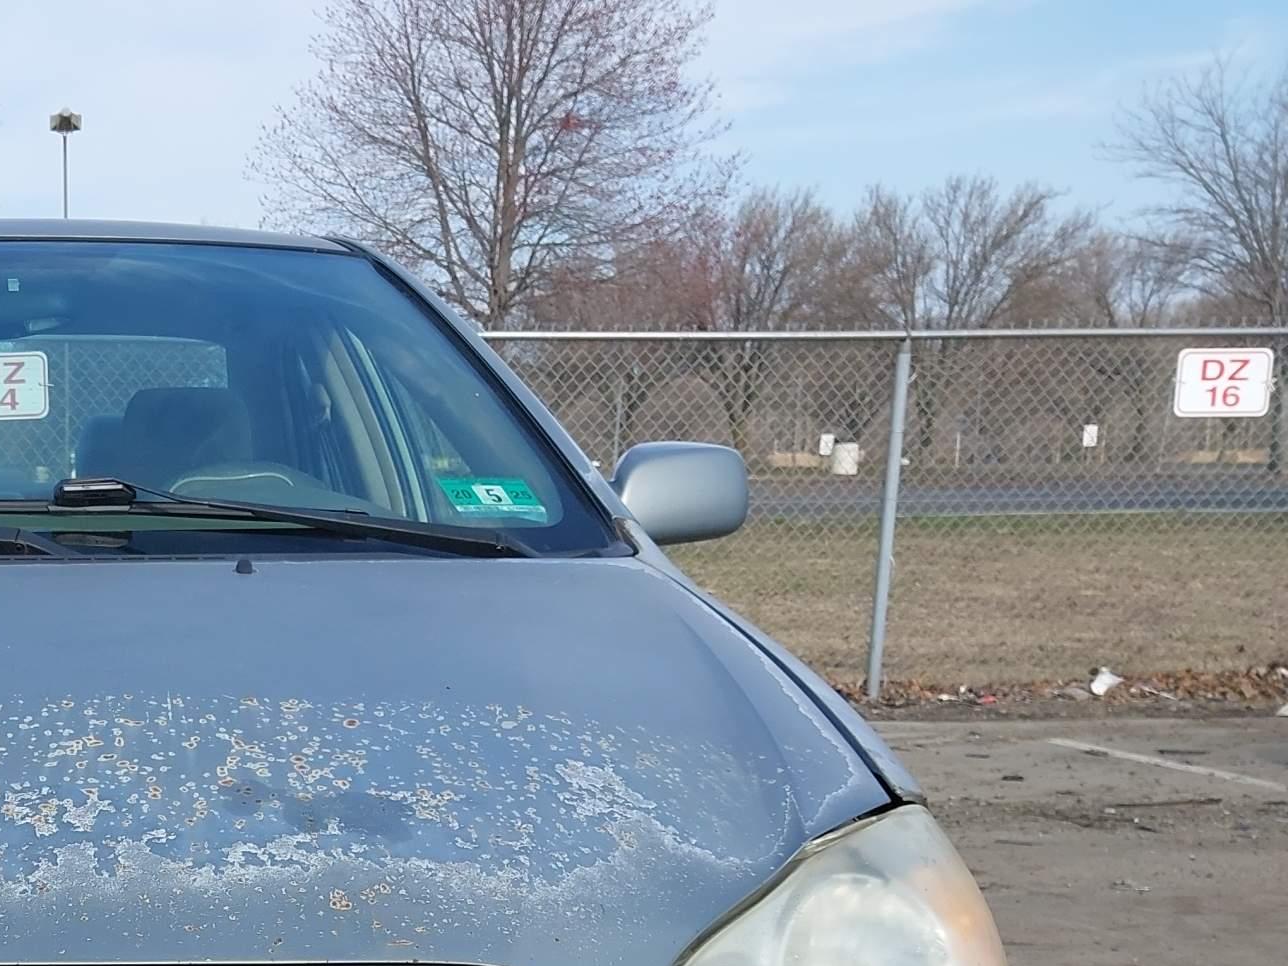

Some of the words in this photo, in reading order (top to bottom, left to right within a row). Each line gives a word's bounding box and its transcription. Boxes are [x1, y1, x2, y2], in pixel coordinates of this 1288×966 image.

[1201, 359, 1251, 381] DZ
[1205, 386, 1241, 407] 16
[451, 488, 473, 500] 20
[485, 488, 503, 503] 5
